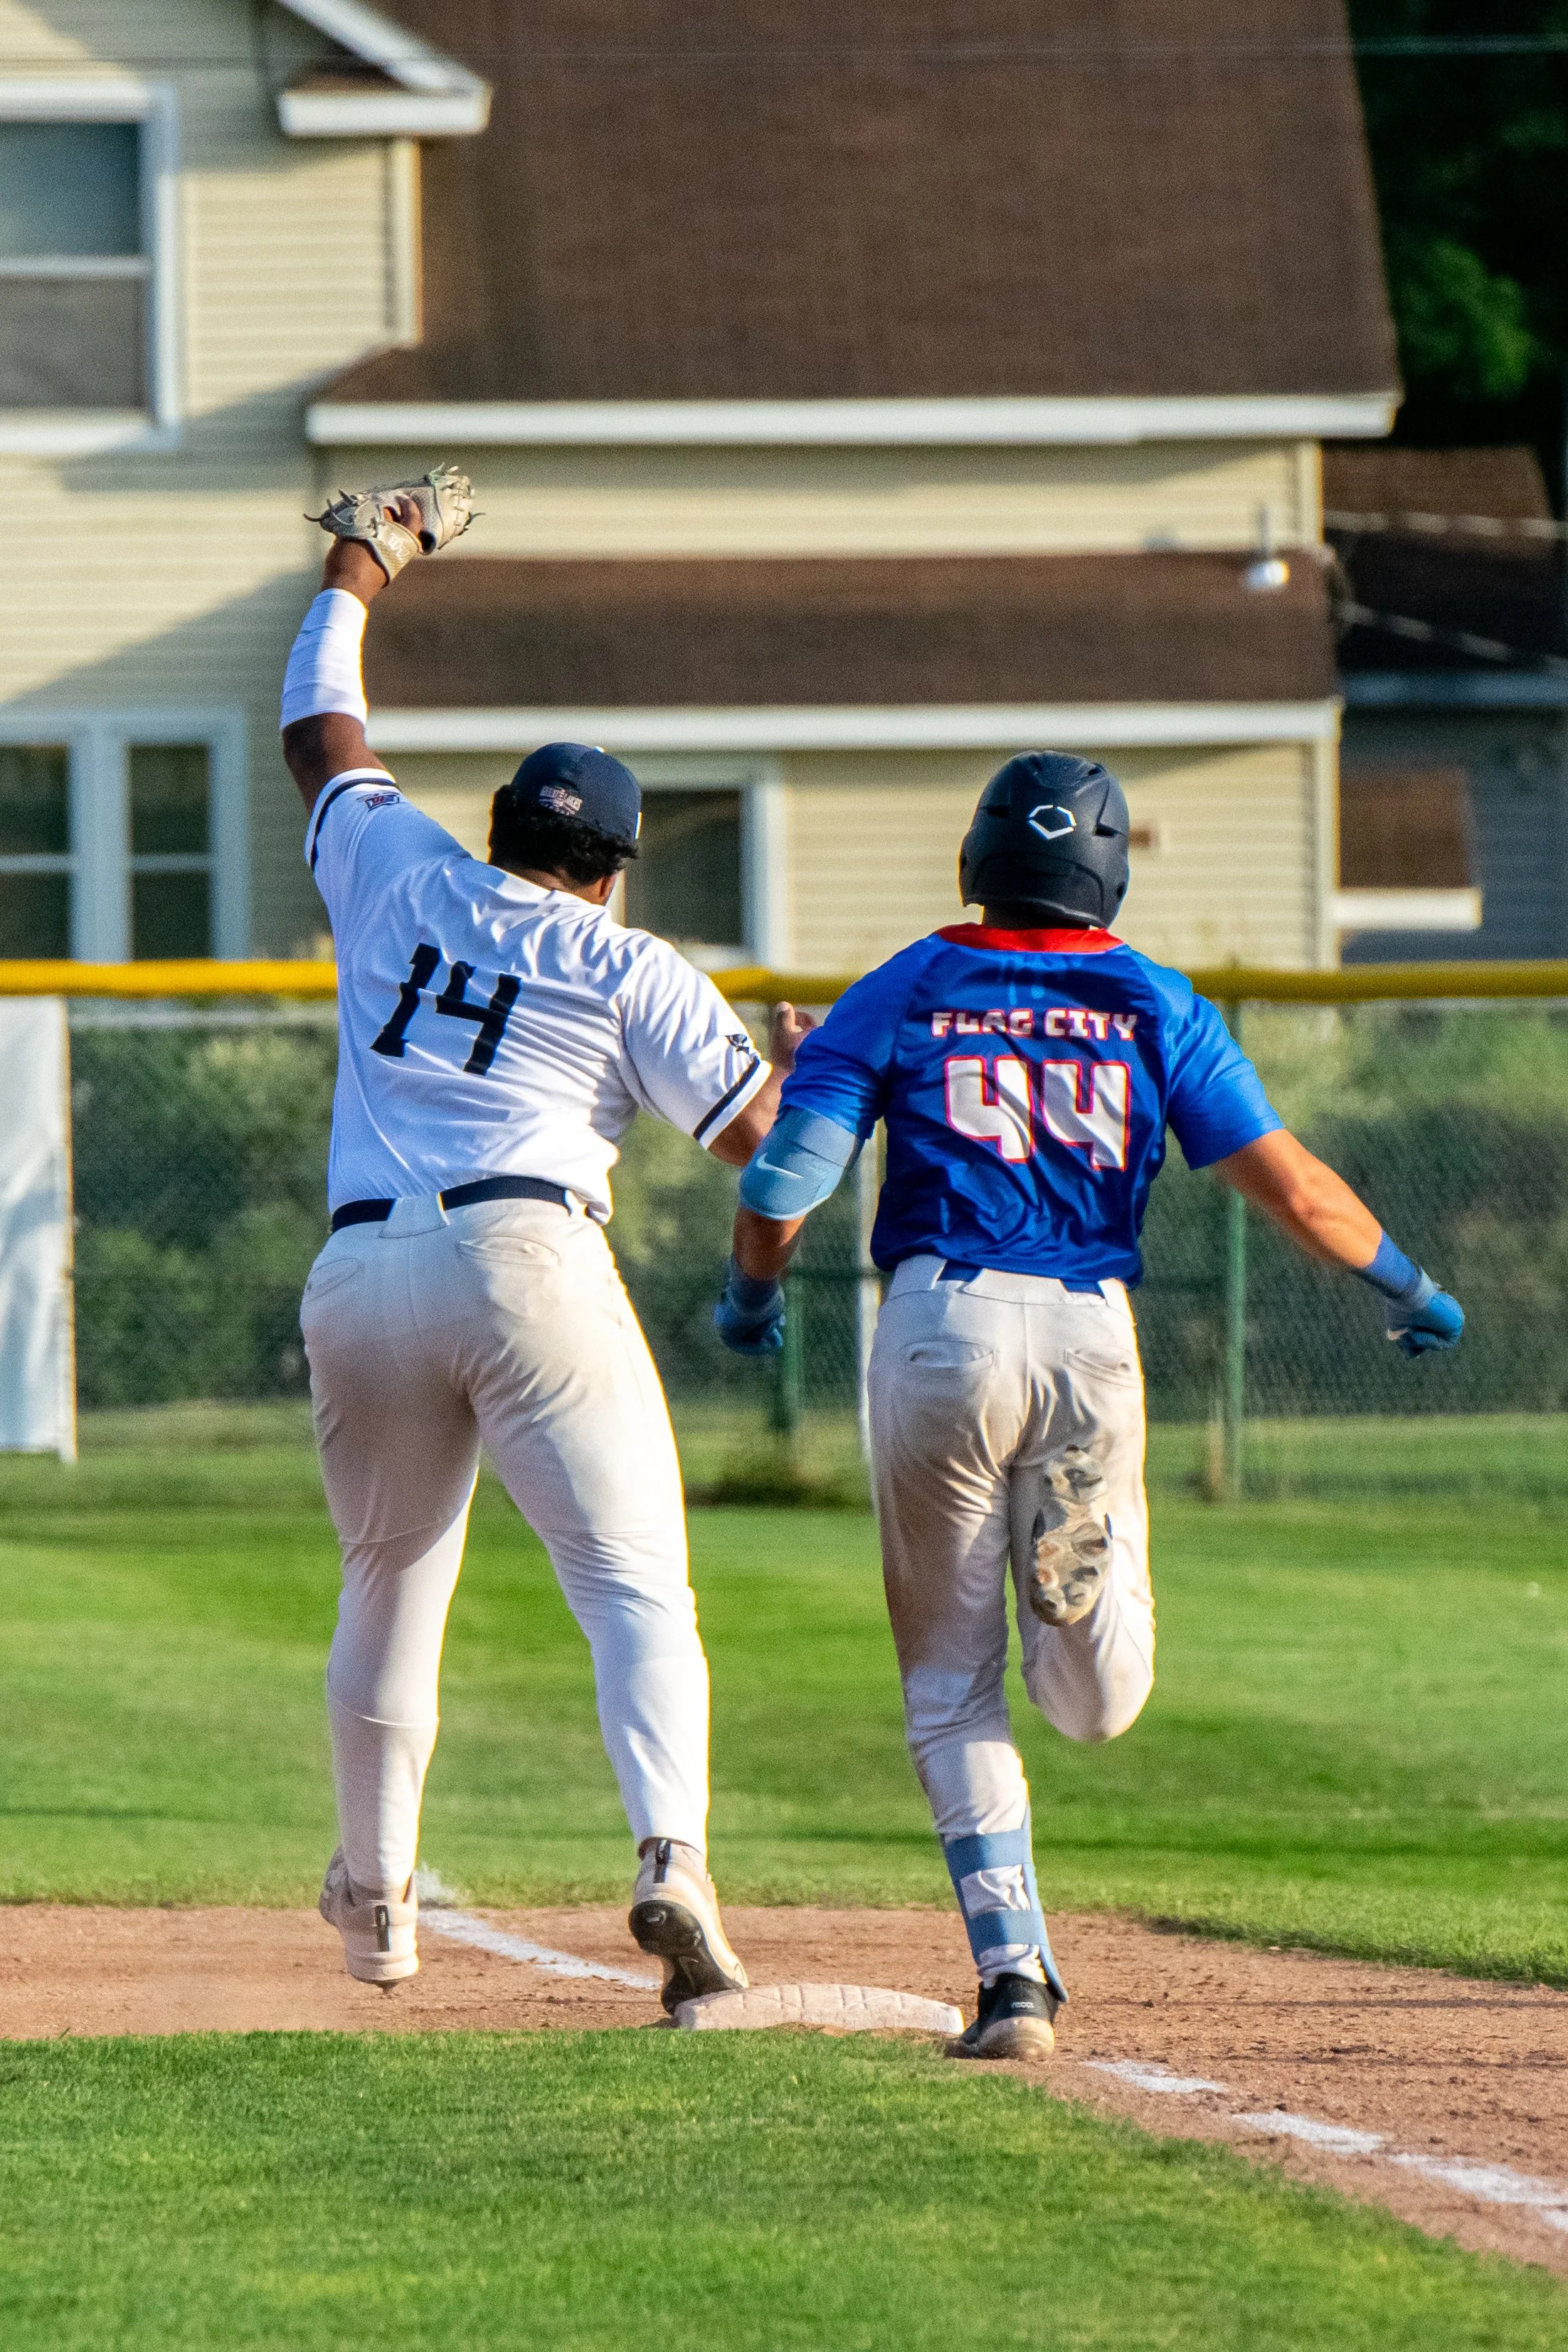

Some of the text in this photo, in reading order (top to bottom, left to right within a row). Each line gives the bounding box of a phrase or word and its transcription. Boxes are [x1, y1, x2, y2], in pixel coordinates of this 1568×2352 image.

[369, 942, 522, 1076] 14
[931, 1007, 1138, 1040] FLAG CITY
[944, 1055, 1131, 1172] 44
